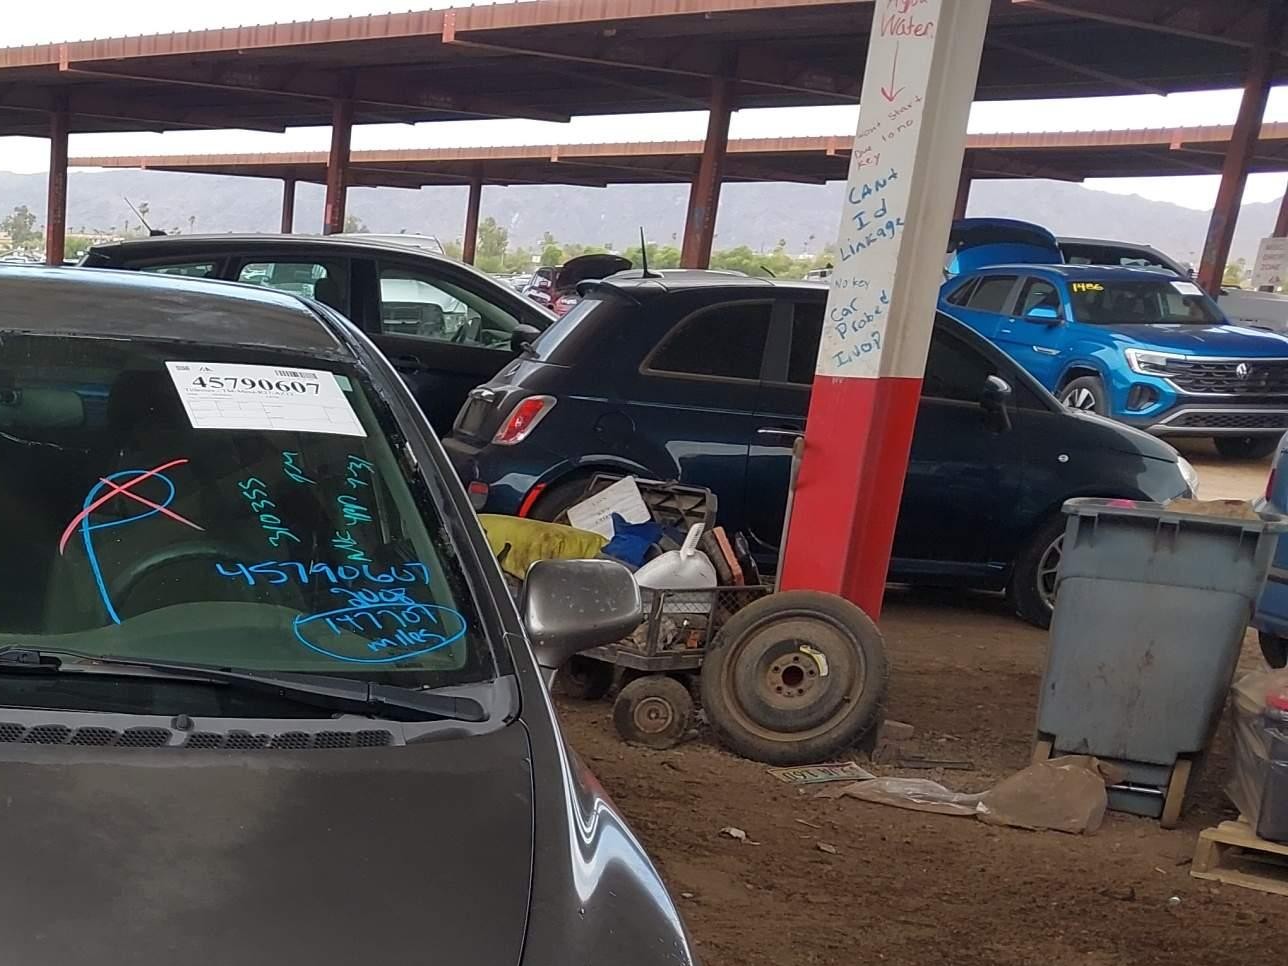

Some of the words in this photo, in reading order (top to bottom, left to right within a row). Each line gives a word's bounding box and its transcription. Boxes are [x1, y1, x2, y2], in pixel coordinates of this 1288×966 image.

[880, 14, 934, 37] Water
[192, 376, 321, 395] 45790607
[215, 561, 430, 585] 45790607
